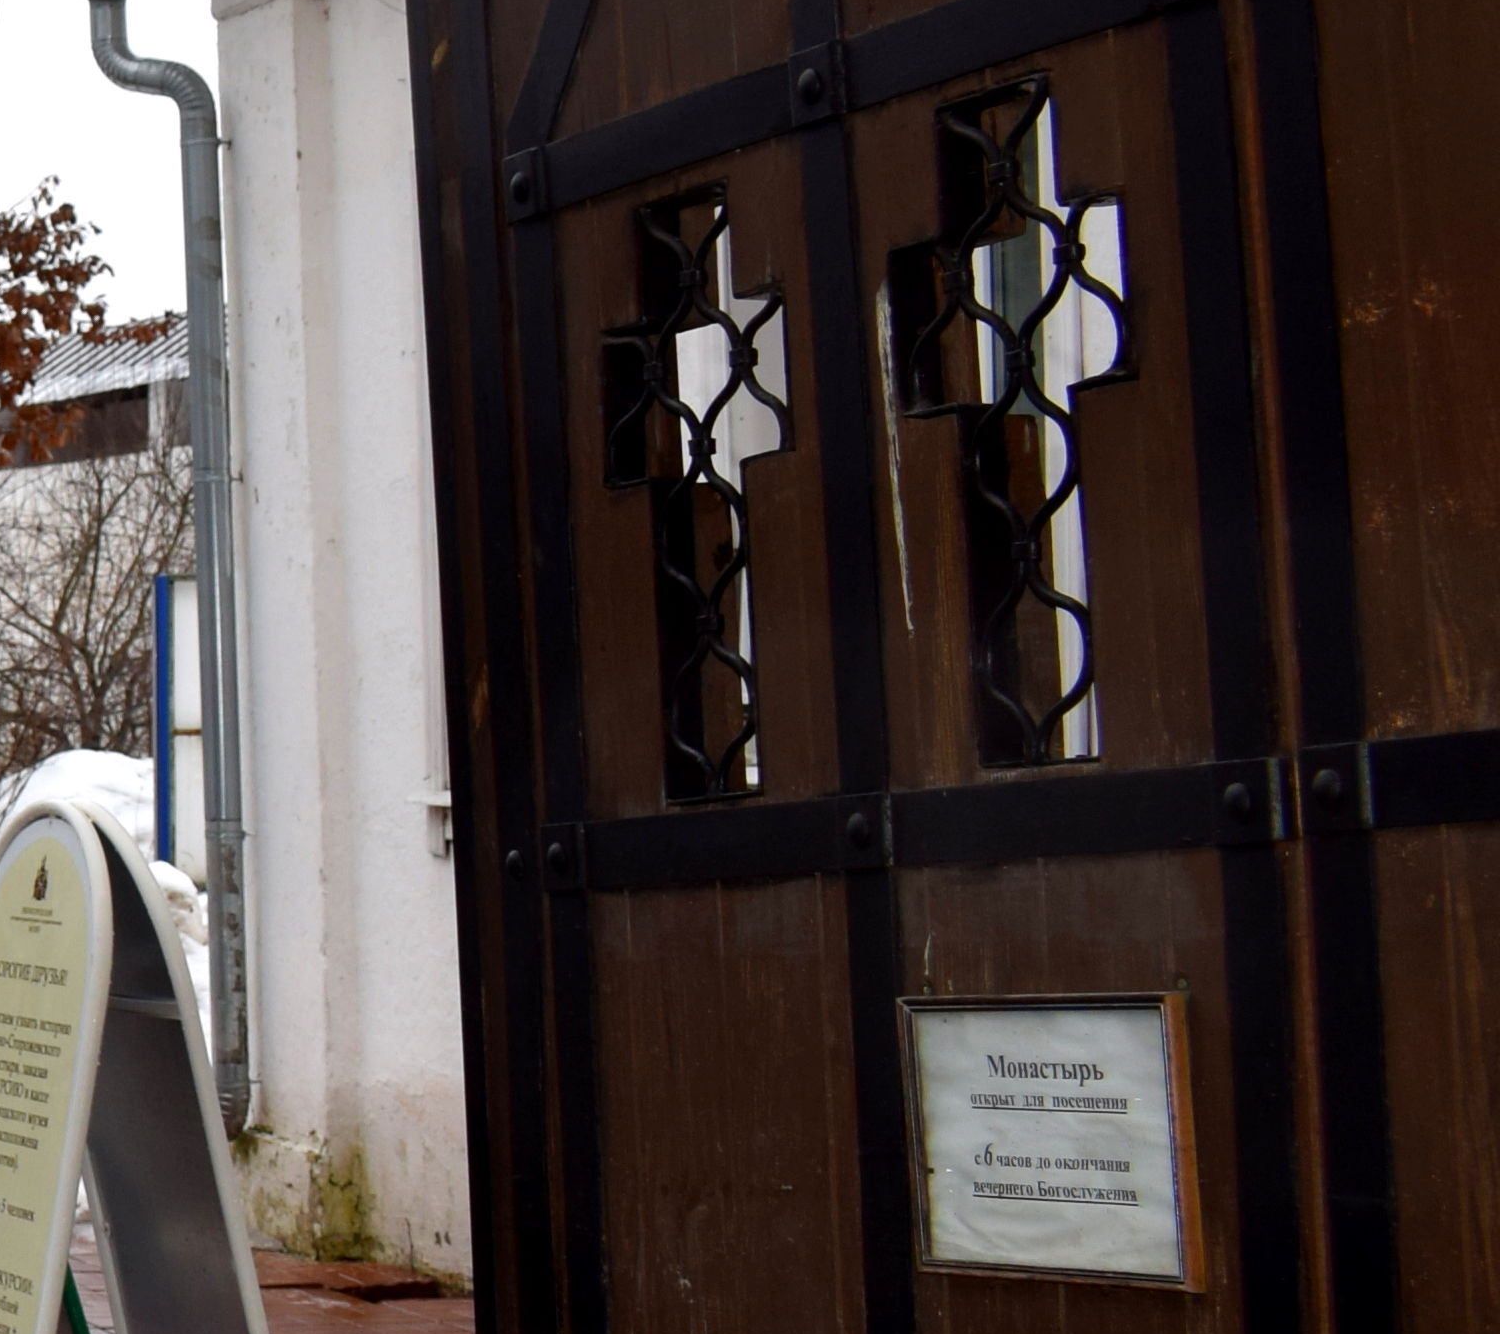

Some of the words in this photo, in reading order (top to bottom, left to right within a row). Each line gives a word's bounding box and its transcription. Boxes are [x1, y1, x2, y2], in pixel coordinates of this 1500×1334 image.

[987, 1054, 1104, 1087] Монастырь
[970, 1092, 1015, 1109] открыт
[1022, 1094, 1045, 1109] для
[1052, 1095, 1128, 1112] посещения
[974, 1154, 981, 1166] с
[983, 1142, 993, 1166] 6
[996, 1154, 1032, 1169] часов
[1035, 1157, 1051, 1171] до
[1054, 1157, 1130, 1173] окончания
[973, 1182, 1034, 1199] вечернего
[1037, 1180, 1137, 1203] Богослужения
